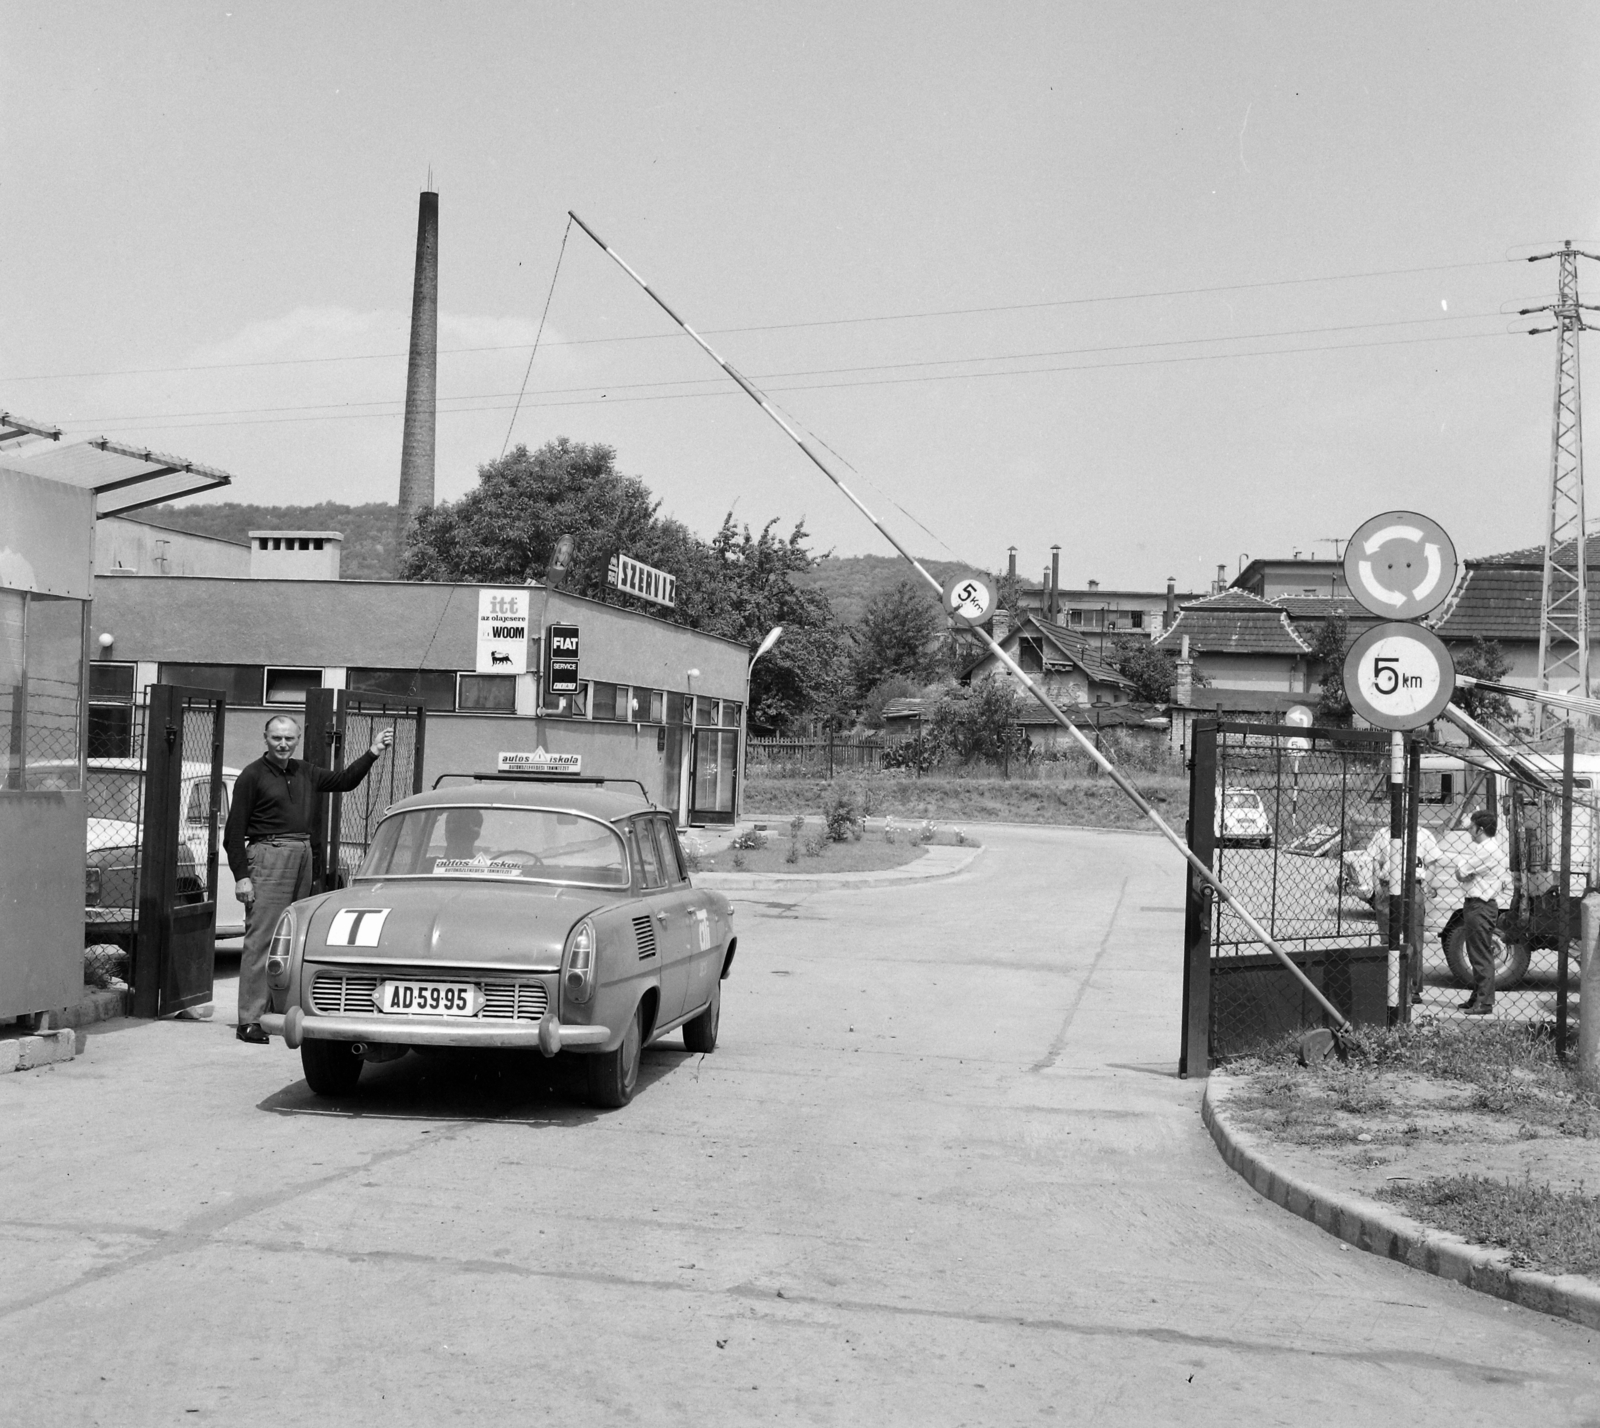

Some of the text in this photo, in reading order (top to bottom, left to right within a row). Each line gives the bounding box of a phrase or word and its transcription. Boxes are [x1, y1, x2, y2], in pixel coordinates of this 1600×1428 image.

[621, 561, 675, 603] SZERVIZ
[958, 583, 977, 602] 5
[489, 596, 518, 614] itt
[491, 615, 526, 623] olajcsere
[553, 637, 578, 650] FIAT
[1374, 658, 1422, 695] 5 km
[549, 755, 579, 764] iskola
[344, 910, 383, 946] T
